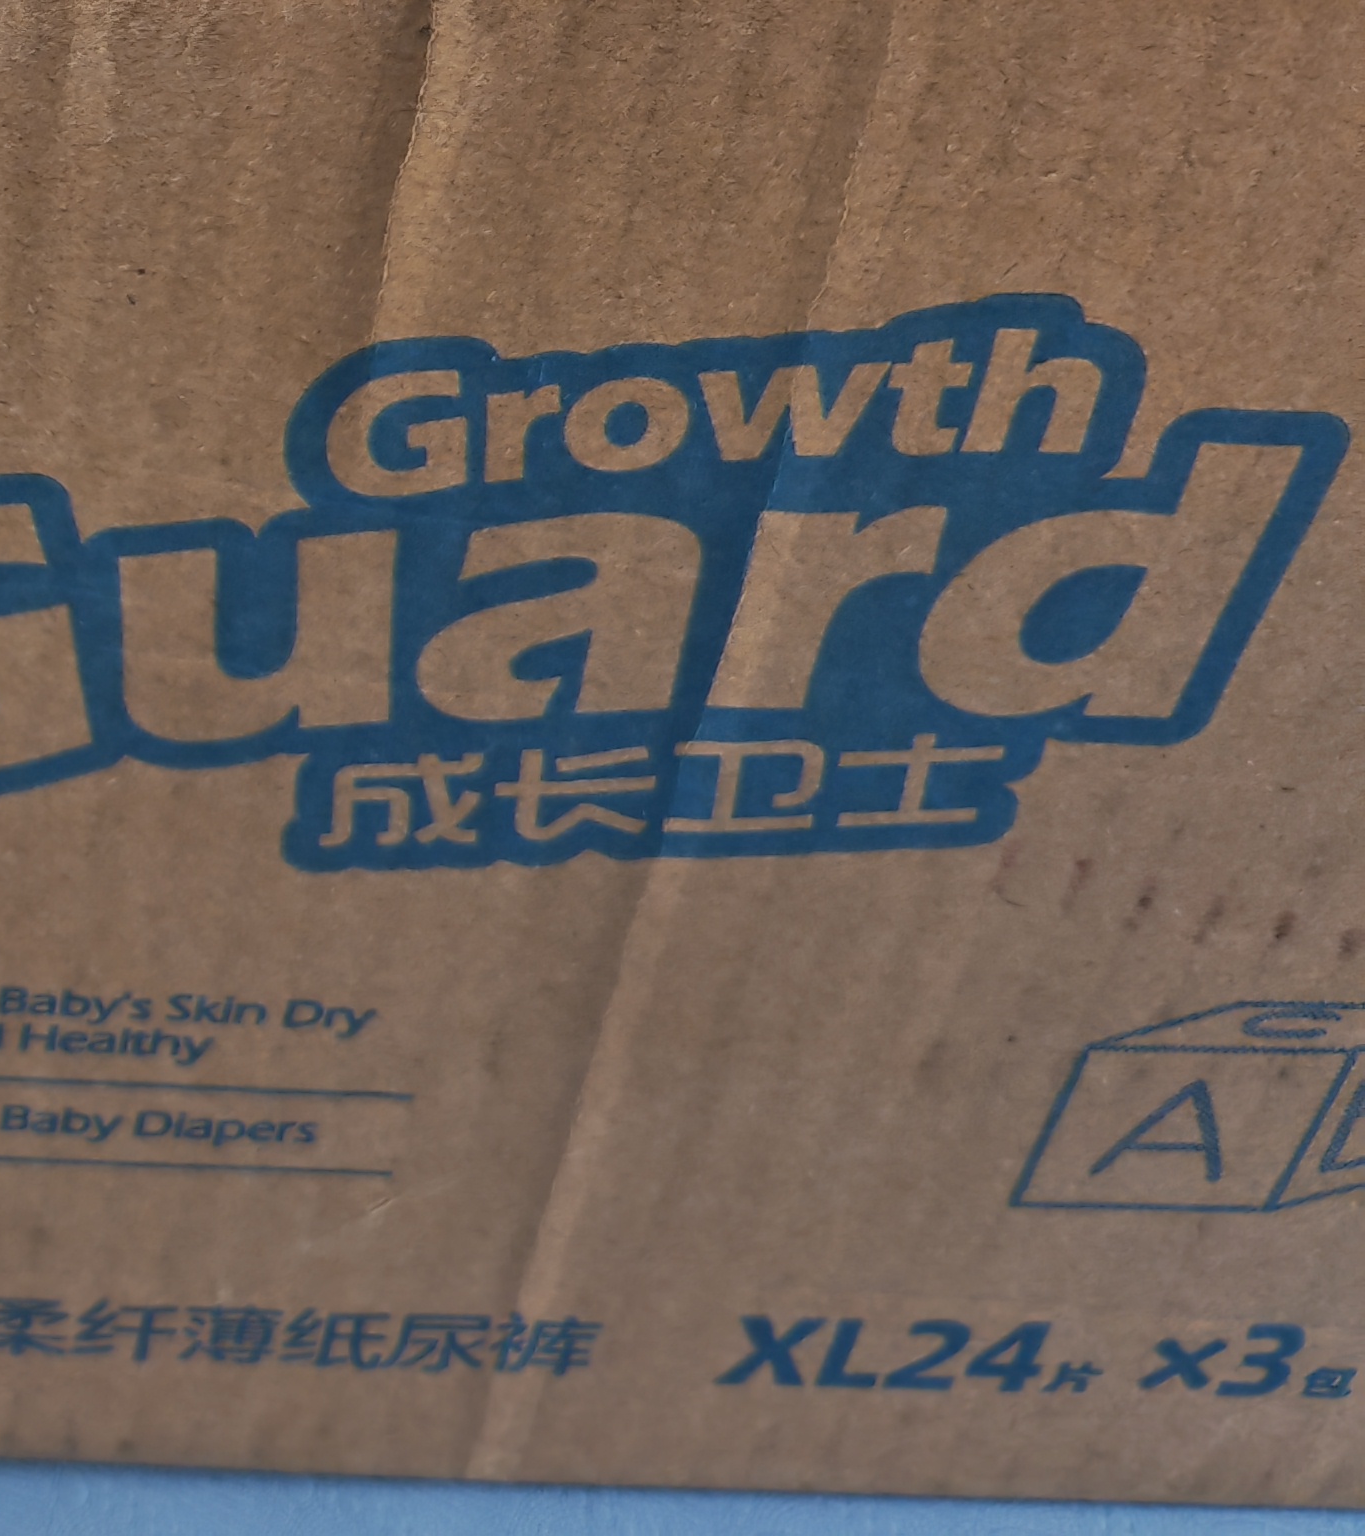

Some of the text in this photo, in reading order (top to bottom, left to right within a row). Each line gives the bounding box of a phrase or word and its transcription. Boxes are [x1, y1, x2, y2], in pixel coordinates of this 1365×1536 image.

[319, 326, 1103, 496] Growth
[315, 732, 1007, 846] 成长卫士
[18, 1022, 216, 1068] Healthy
[165, 993, 269, 1027] Skin
[282, 999, 378, 1041] Dry
[133, 1110, 320, 1150] Diapers
[1087, 1078, 1225, 1184] A
